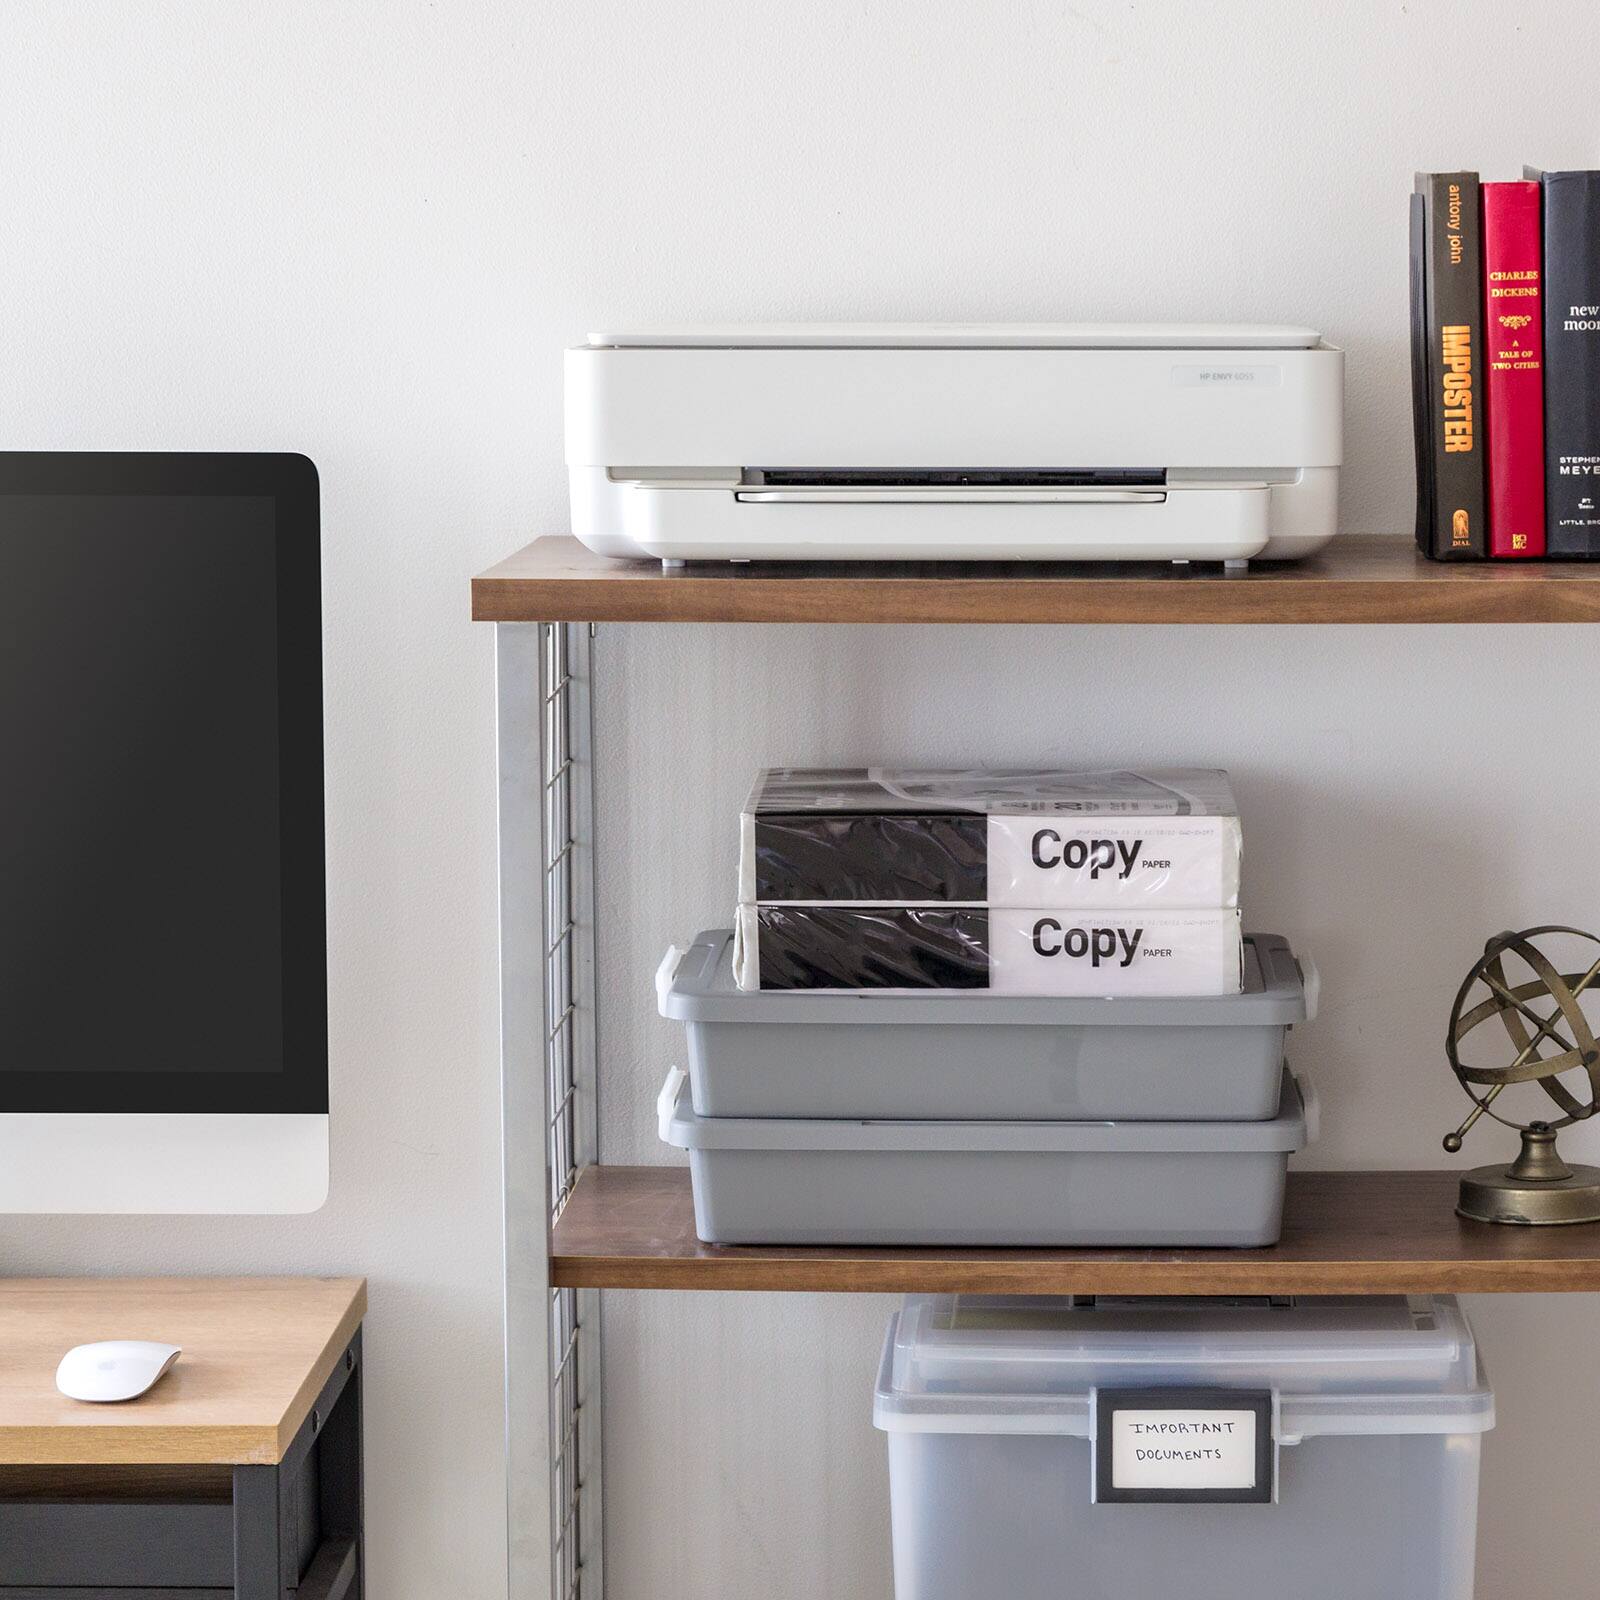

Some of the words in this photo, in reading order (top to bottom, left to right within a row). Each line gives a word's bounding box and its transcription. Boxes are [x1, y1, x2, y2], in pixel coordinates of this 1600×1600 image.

[1447, 185, 1462, 230] antony
[1447, 234, 1463, 264] john
[1490, 271, 1538, 281] CHARLES
[1491, 287, 1538, 298] DICKENS
[1569, 305, 1600, 317] new
[1498, 351, 1520, 359] TALE
[1521, 350, 1534, 358] OF
[1492, 362, 1512, 370] TWO
[1513, 361, 1540, 369] CITIES
[1200, 372, 1211, 381] HP
[1212, 372, 1232, 381] ENVY
[1442, 325, 1473, 453] IMPOSTER
[1452, 539, 1470, 547] DIAL
[1031, 829, 1143, 880] Copy
[1142, 860, 1171, 869] PAPER
[1032, 918, 1143, 967] Copy
[1143, 948, 1172, 957] PAPER
[1129, 1422, 1235, 1434] IMPORTANT
[1136, 1448, 1222, 1461] DOCUMENTS
